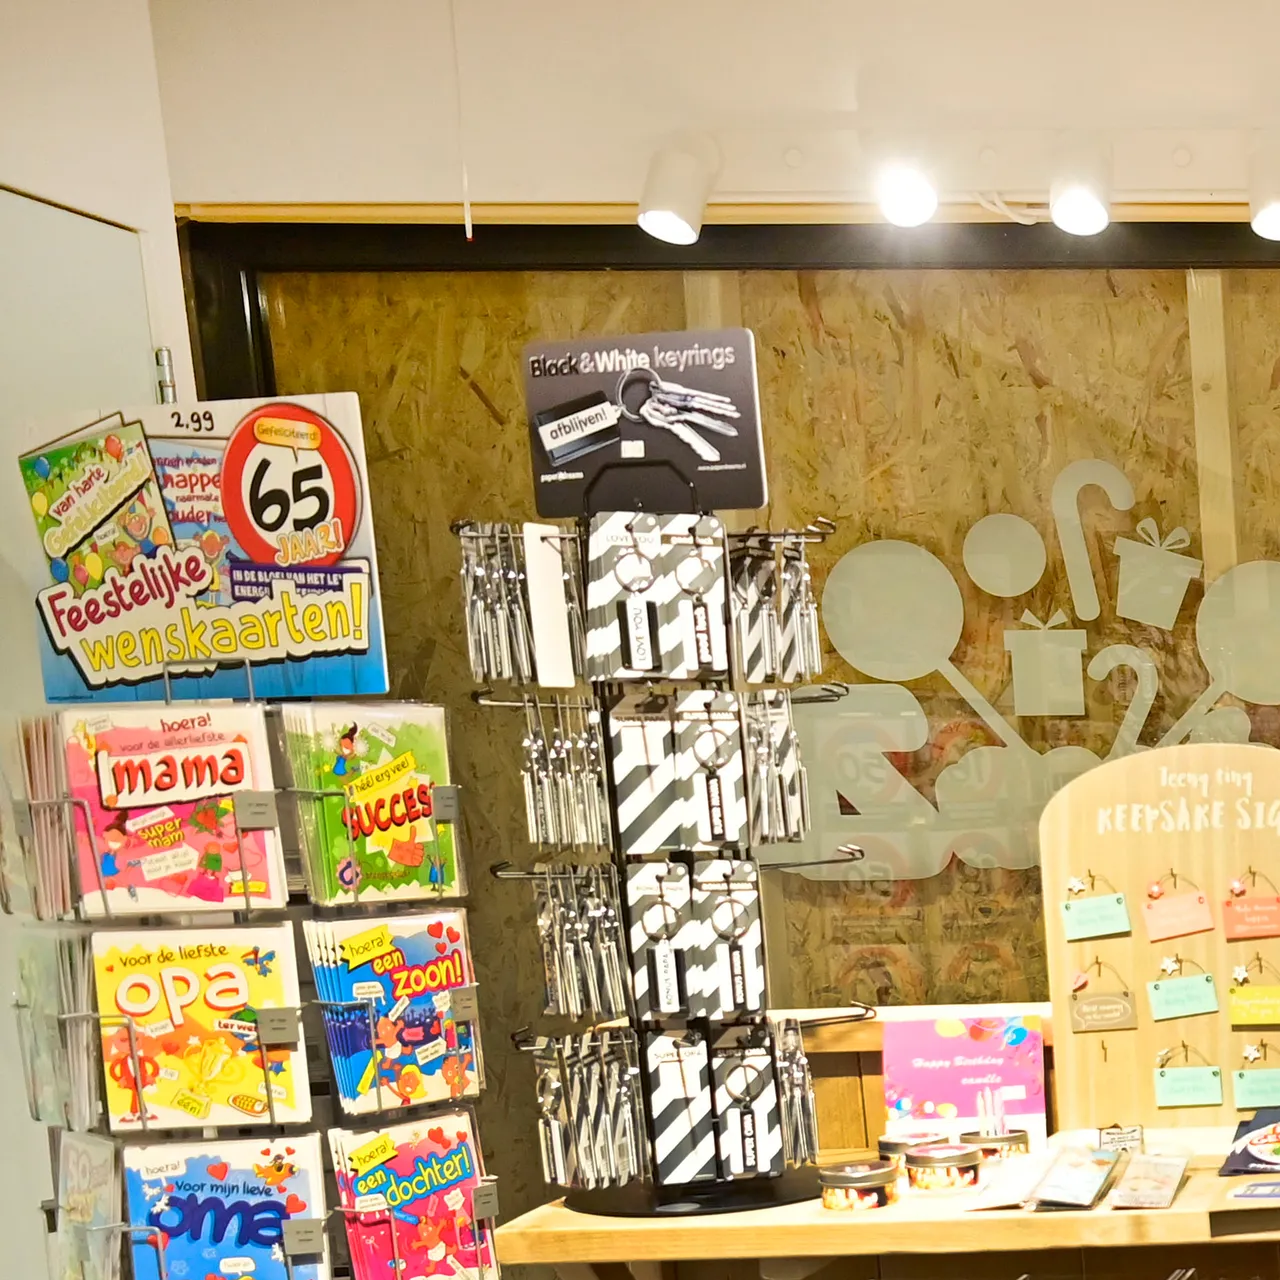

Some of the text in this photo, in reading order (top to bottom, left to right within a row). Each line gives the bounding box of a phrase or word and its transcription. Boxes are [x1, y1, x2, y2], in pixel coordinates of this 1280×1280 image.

[654, 343, 736, 372] keyrings
[171, 411, 214, 431] 2.99
[550, 408, 608, 441] afblijven!
[53, 467, 105, 517] van harte
[250, 458, 329, 532] 65
[277, 520, 342, 562] JAAR!
[606, 534, 629, 542] LOVE
[243, 570, 256, 582] DE
[307, 572, 325, 583] HET
[48, 552, 206, 638] Feestelijke
[80, 582, 364, 672] wenskaarten!
[633, 607, 646, 661] LOVE YOU
[160, 713, 211, 733] hoera!
[119, 741, 143, 752] voor
[148, 737, 160, 750] de
[112, 748, 245, 794] mama
[355, 756, 409, 793] héél erg veel
[1216, 768, 1253, 798] tiny
[342, 782, 436, 841] SUCCES
[1097, 800, 1225, 836] KEEPSAKE
[137, 817, 182, 840] super
[148, 831, 185, 848] mam
[157, 943, 229, 964] de liefste
[349, 932, 385, 957] hoera!
[373, 951, 404, 973] een
[115, 962, 249, 1029] opa
[912, 1055, 1004, 1068] Happy Birthday
[961, 1073, 1002, 1085] candle
[356, 1141, 389, 1165] hoera!
[145, 1161, 180, 1175] hoera!
[386, 1147, 470, 1206] dochter!
[210, 1181, 274, 1198] mijn lieve
[357, 1170, 387, 1194] een
[147, 1193, 291, 1248] oma
